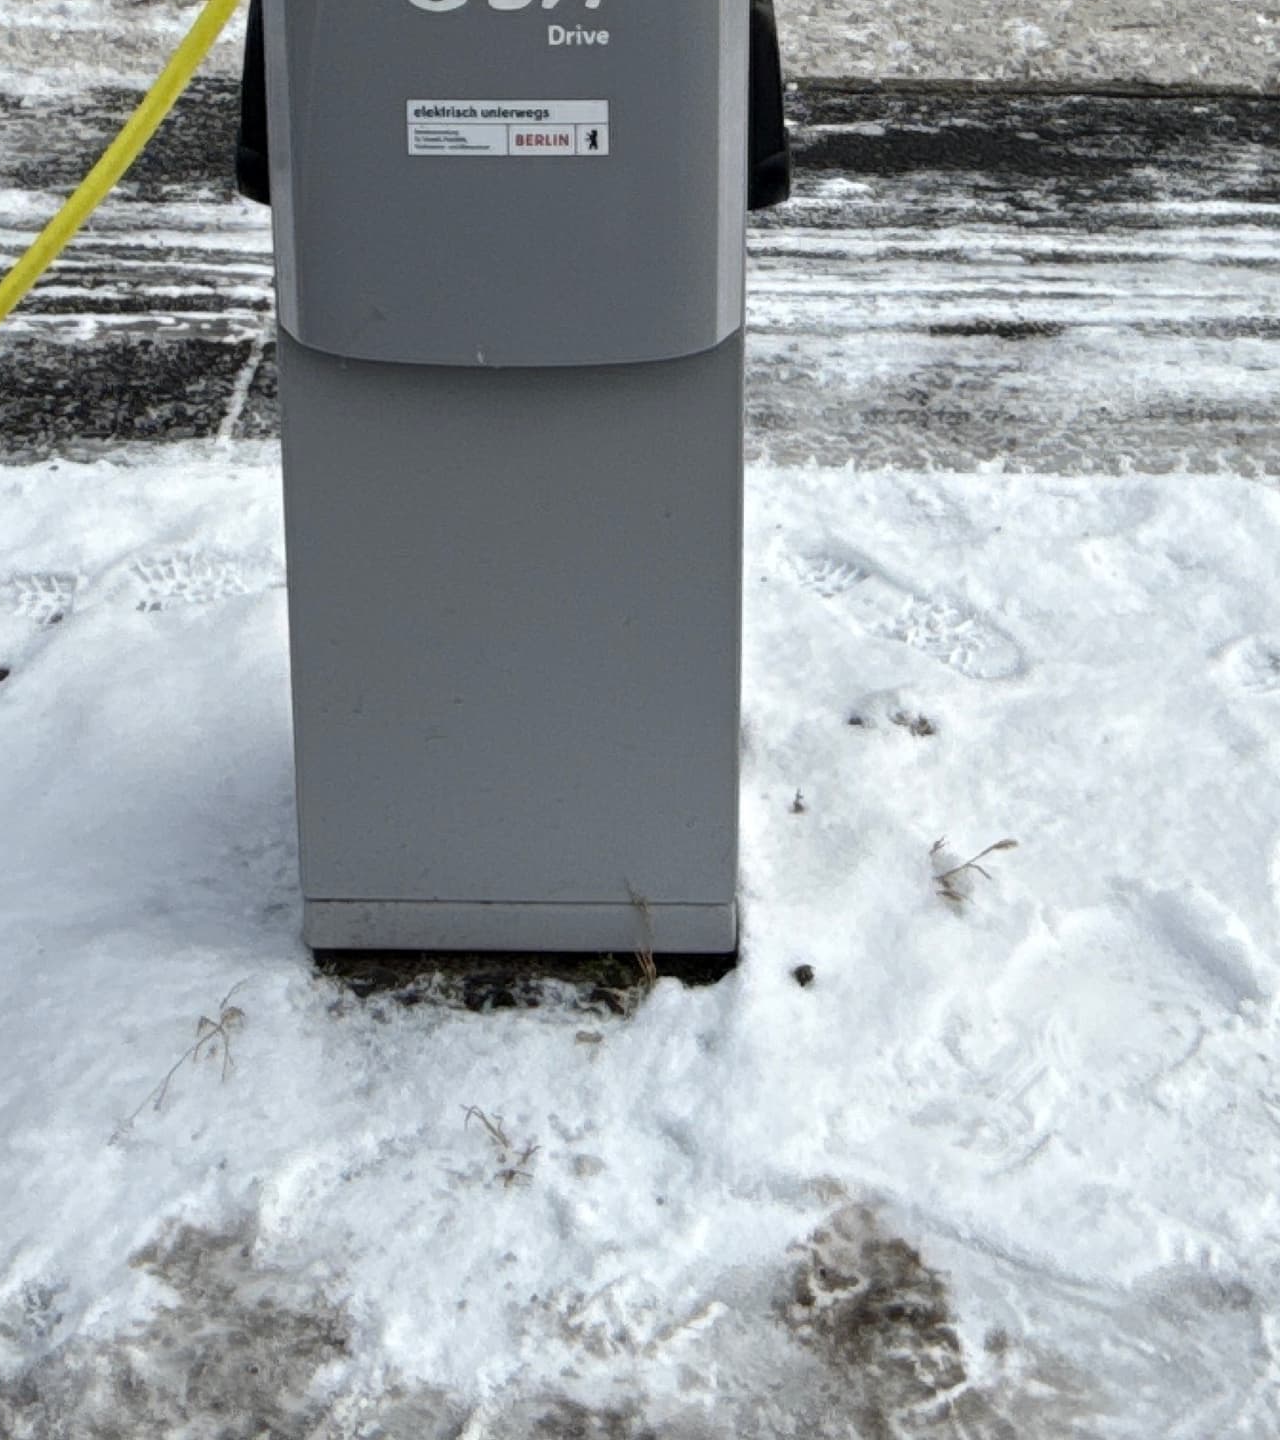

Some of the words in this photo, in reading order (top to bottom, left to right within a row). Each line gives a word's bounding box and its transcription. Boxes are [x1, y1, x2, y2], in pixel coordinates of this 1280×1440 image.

[548, 25, 609, 45] Drive
[413, 106, 477, 118] elektrisch
[481, 107, 549, 120] unterwegs
[515, 134, 569, 147] BERLIN
